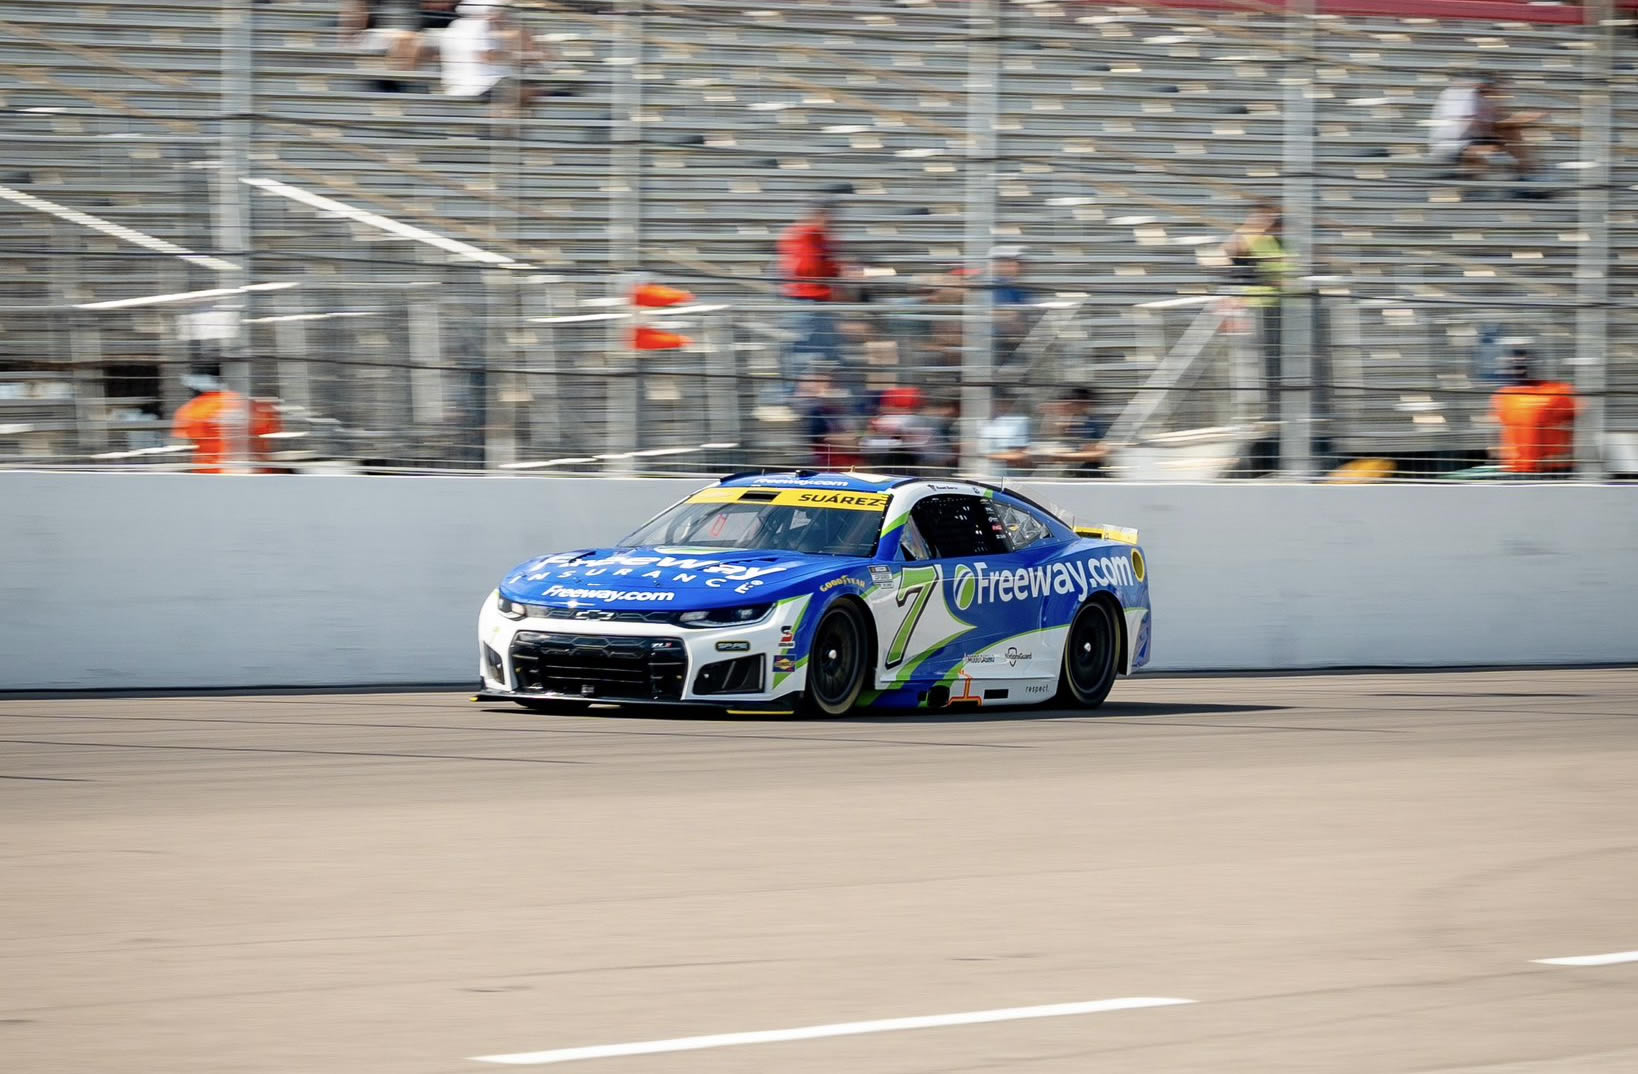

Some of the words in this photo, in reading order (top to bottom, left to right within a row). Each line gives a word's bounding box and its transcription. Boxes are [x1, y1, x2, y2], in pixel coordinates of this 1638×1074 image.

[798, 493, 881, 507] SUÁREZ
[541, 585, 675, 603] Freeway.com
[973, 555, 1134, 605] Freeway.com
[885, 564, 939, 670] 7
